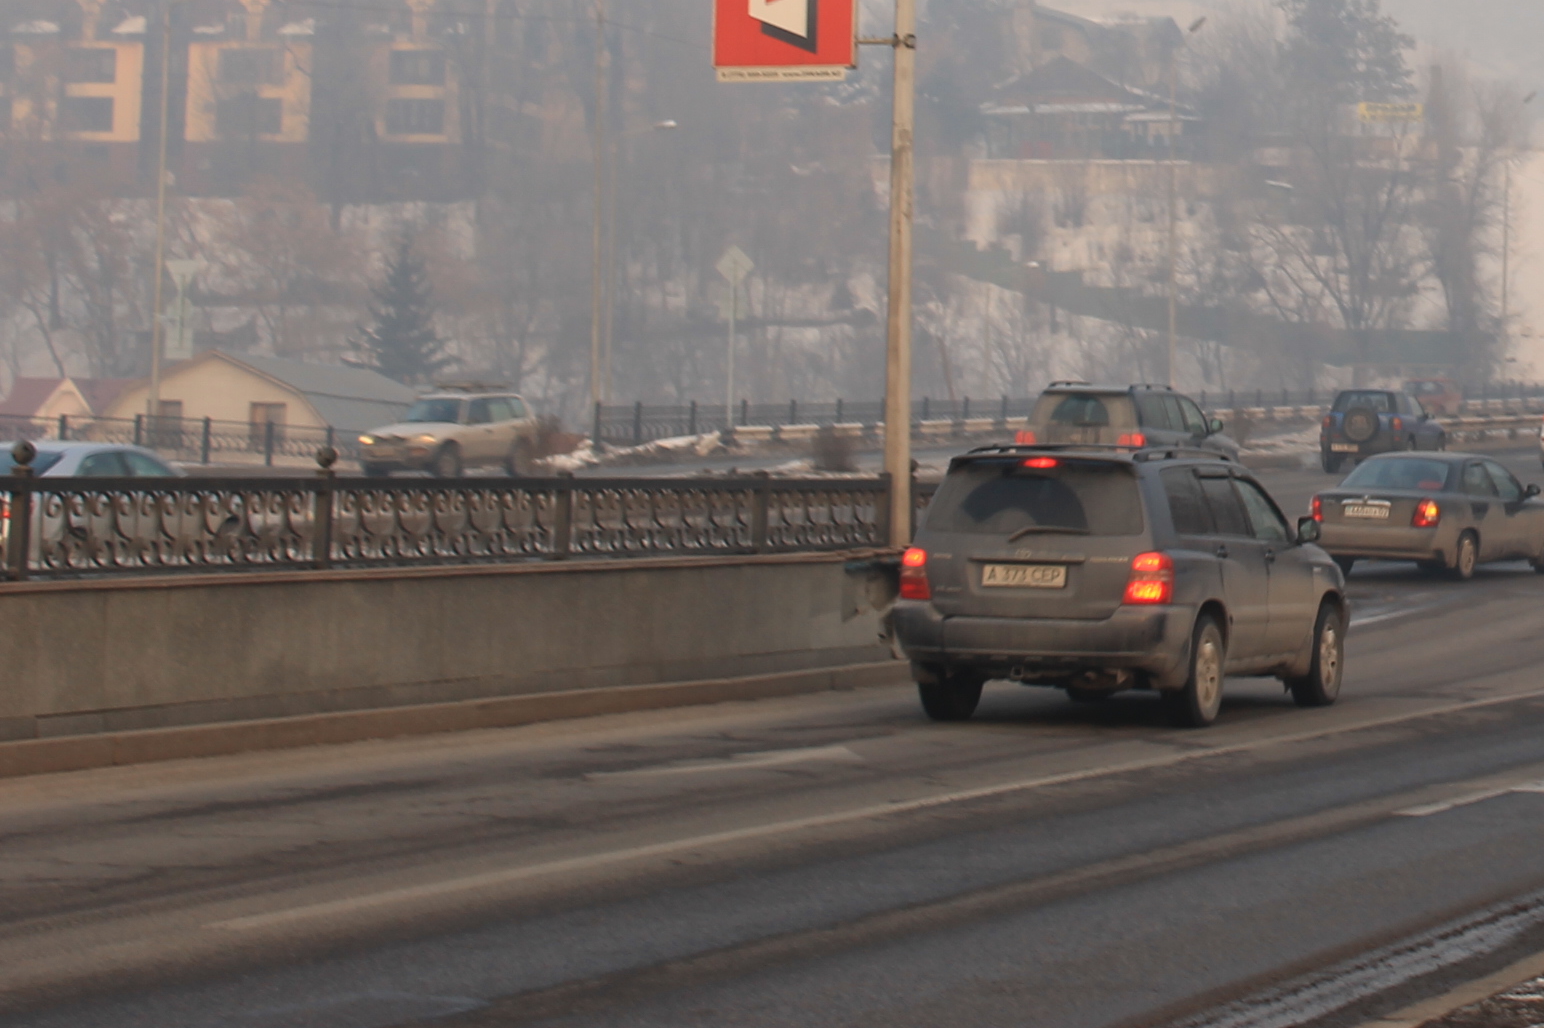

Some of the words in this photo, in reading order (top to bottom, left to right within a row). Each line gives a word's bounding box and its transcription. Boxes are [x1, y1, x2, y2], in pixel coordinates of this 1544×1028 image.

[987, 566, 997, 581] A
[1003, 566, 1027, 582] 373
[1031, 567, 1061, 582] CEP
